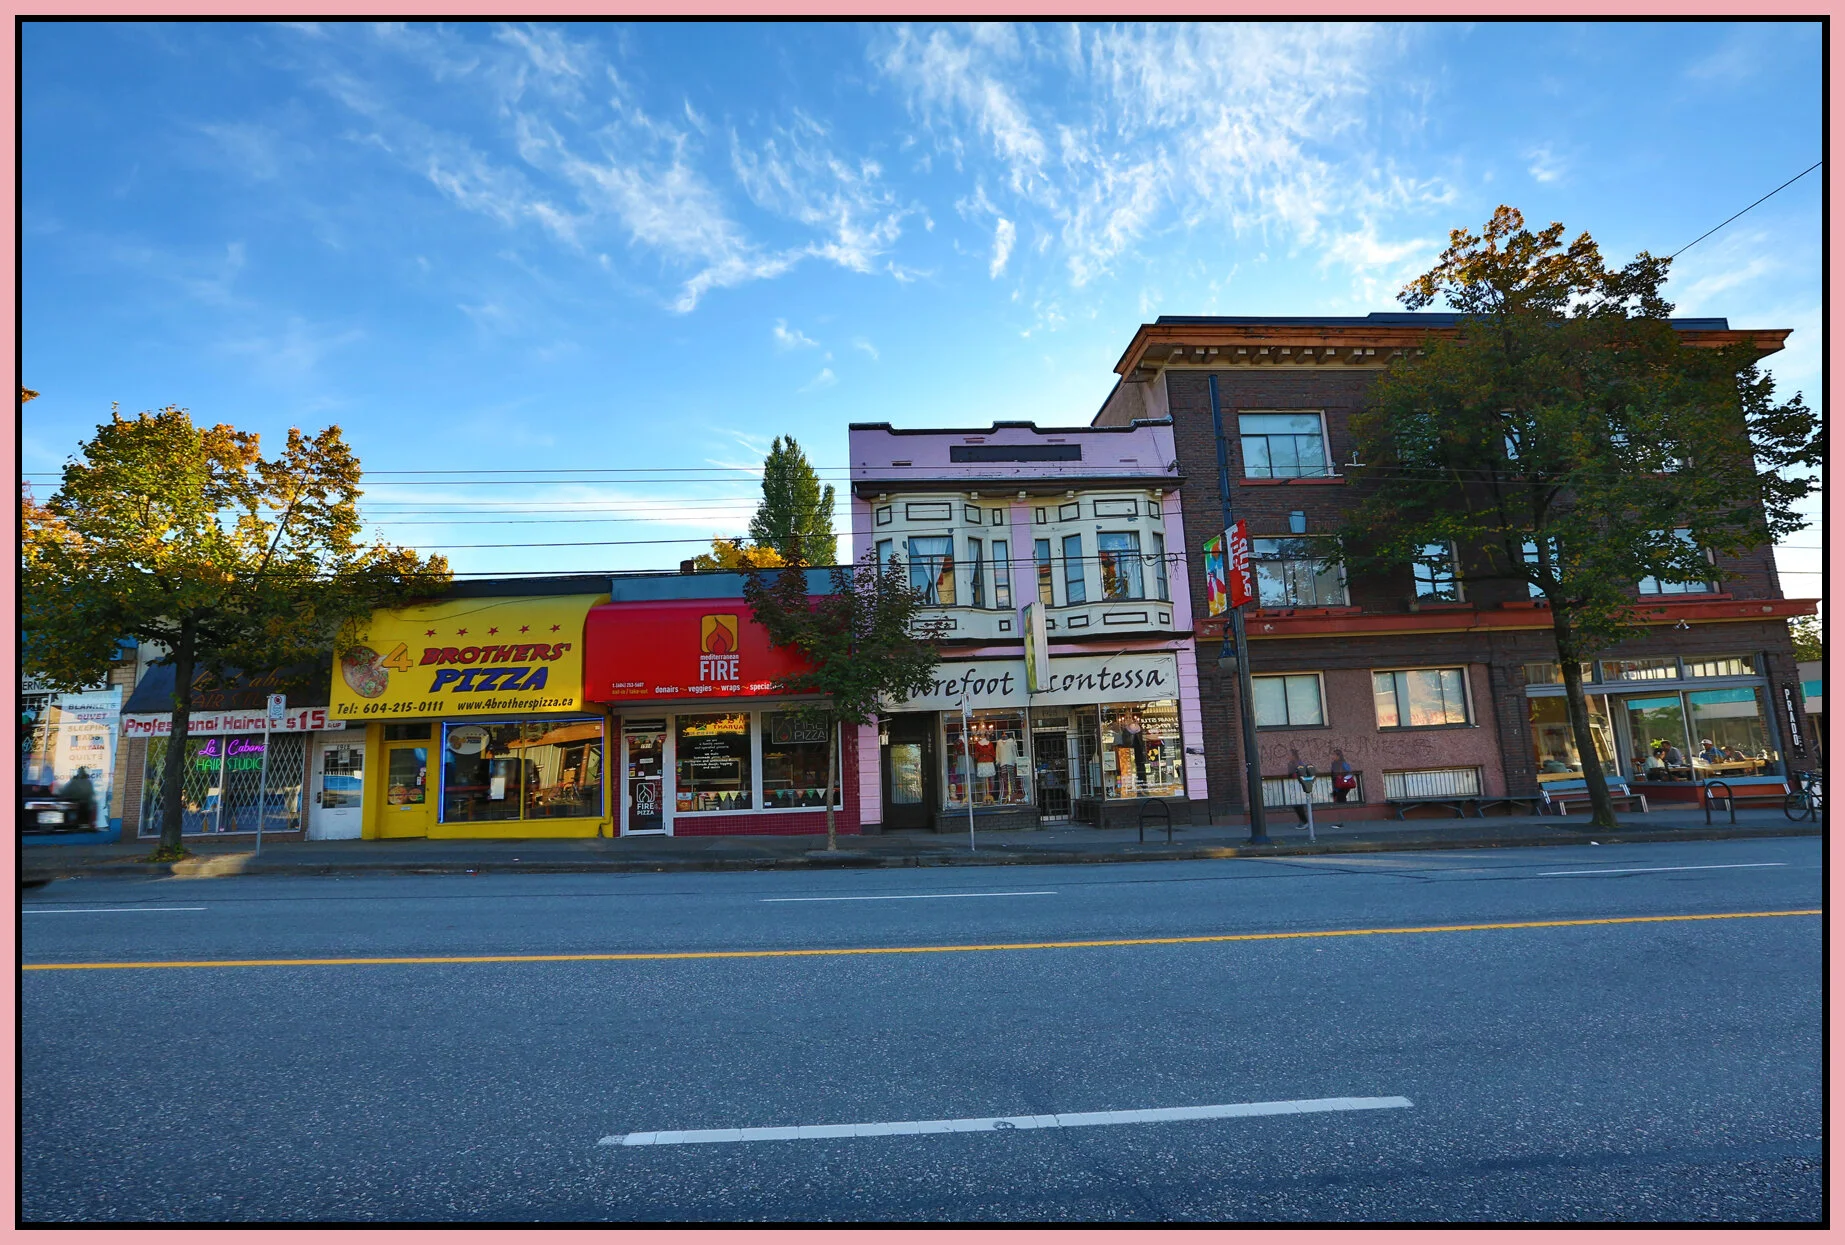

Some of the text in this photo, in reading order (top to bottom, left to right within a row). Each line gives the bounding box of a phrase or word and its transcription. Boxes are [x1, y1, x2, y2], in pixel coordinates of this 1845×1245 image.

[381, 642, 413, 672] 4
[700, 660, 739, 681] FIRE
[429, 667, 549, 693] PIZZA
[655, 686, 679, 694] donairs
[688, 684, 712, 693] veggies
[721, 684, 740, 692] wraps
[337, 701, 444, 714] Tel: 604-215-0111
[457, 697, 574, 711] www.4brotherspizza.ca
[1784, 688, 1799, 746] PRADO
[794, 729, 826, 741] PIZZA
[198, 739, 222, 757] La
[196, 757, 264, 771] HAIR STUDIO
